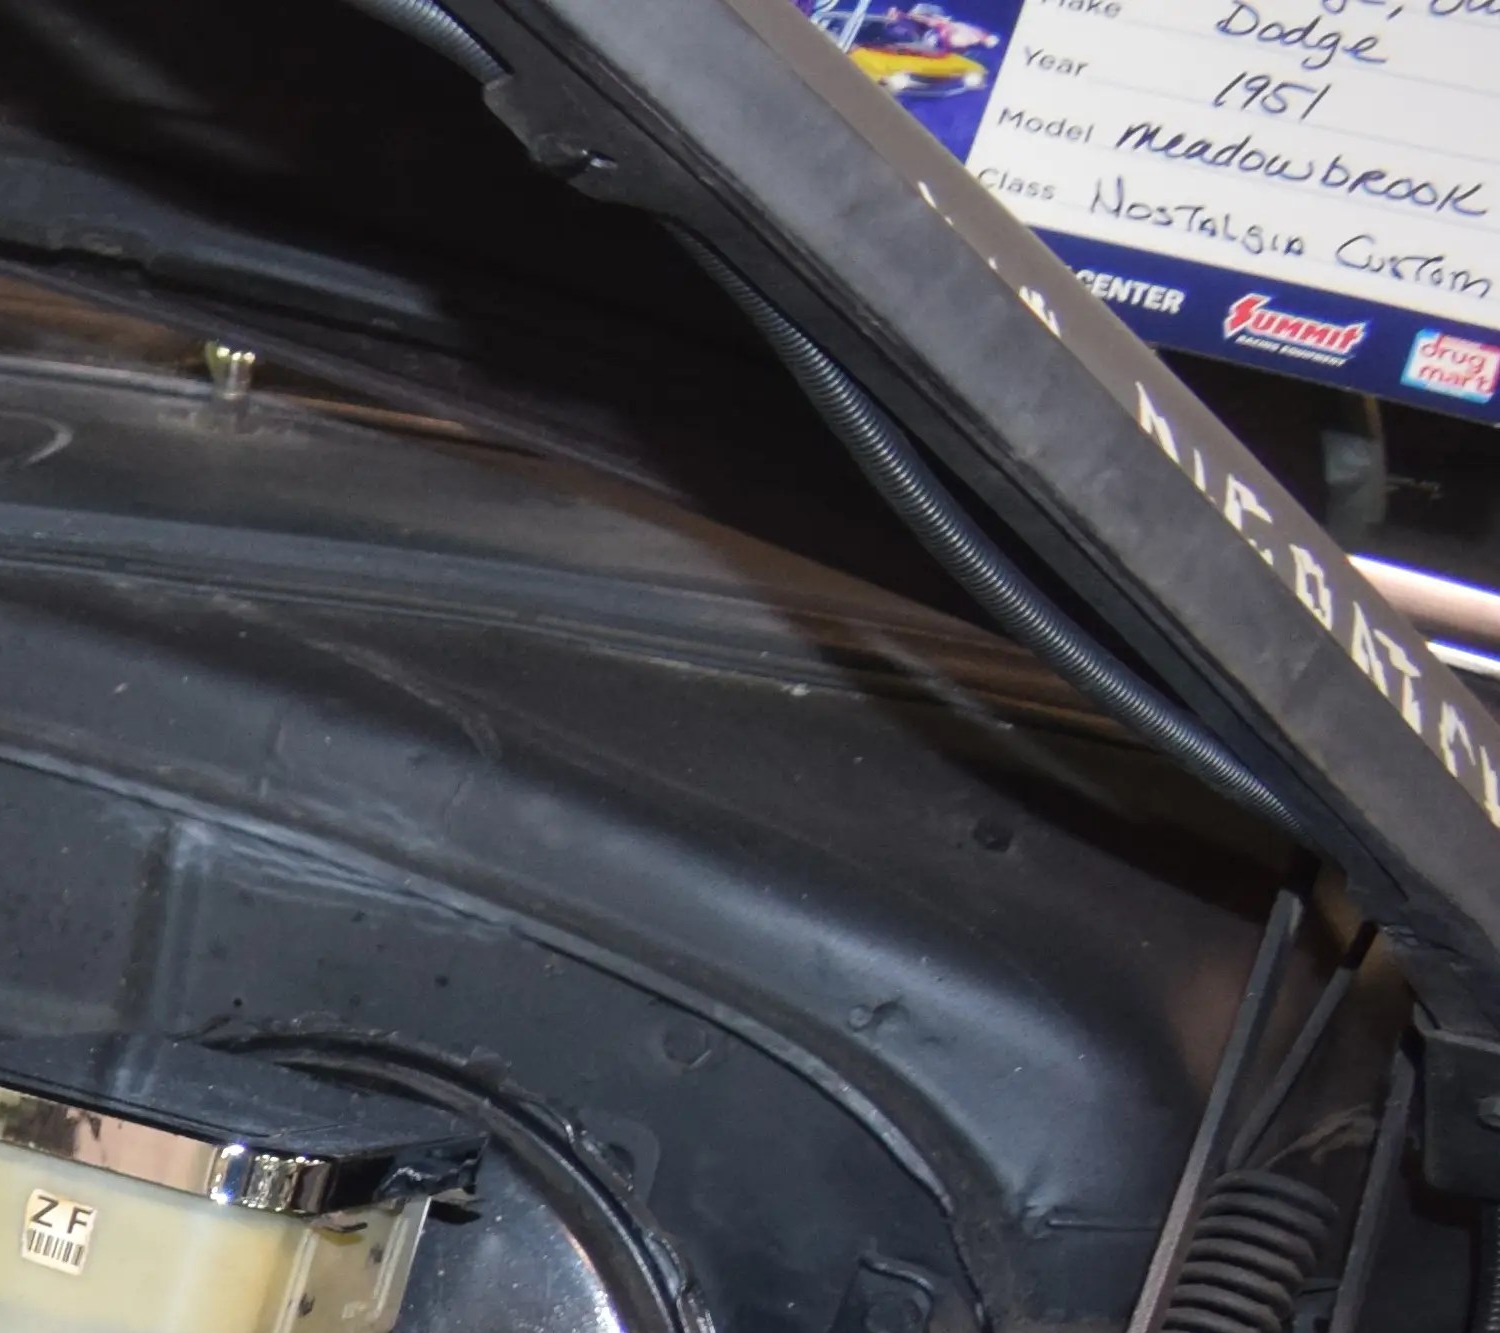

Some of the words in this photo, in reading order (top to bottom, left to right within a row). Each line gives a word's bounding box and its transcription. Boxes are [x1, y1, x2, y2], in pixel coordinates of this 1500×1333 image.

[1040, 0, 1120, 19] ake
[1215, 1, 1388, 70] Dodge
[1023, 48, 1088, 78] Year
[1212, 72, 1332, 120] 1951
[998, 107, 1094, 143] Model
[976, 167, 1056, 202] Class
[1420, 334, 1486, 376] drug
